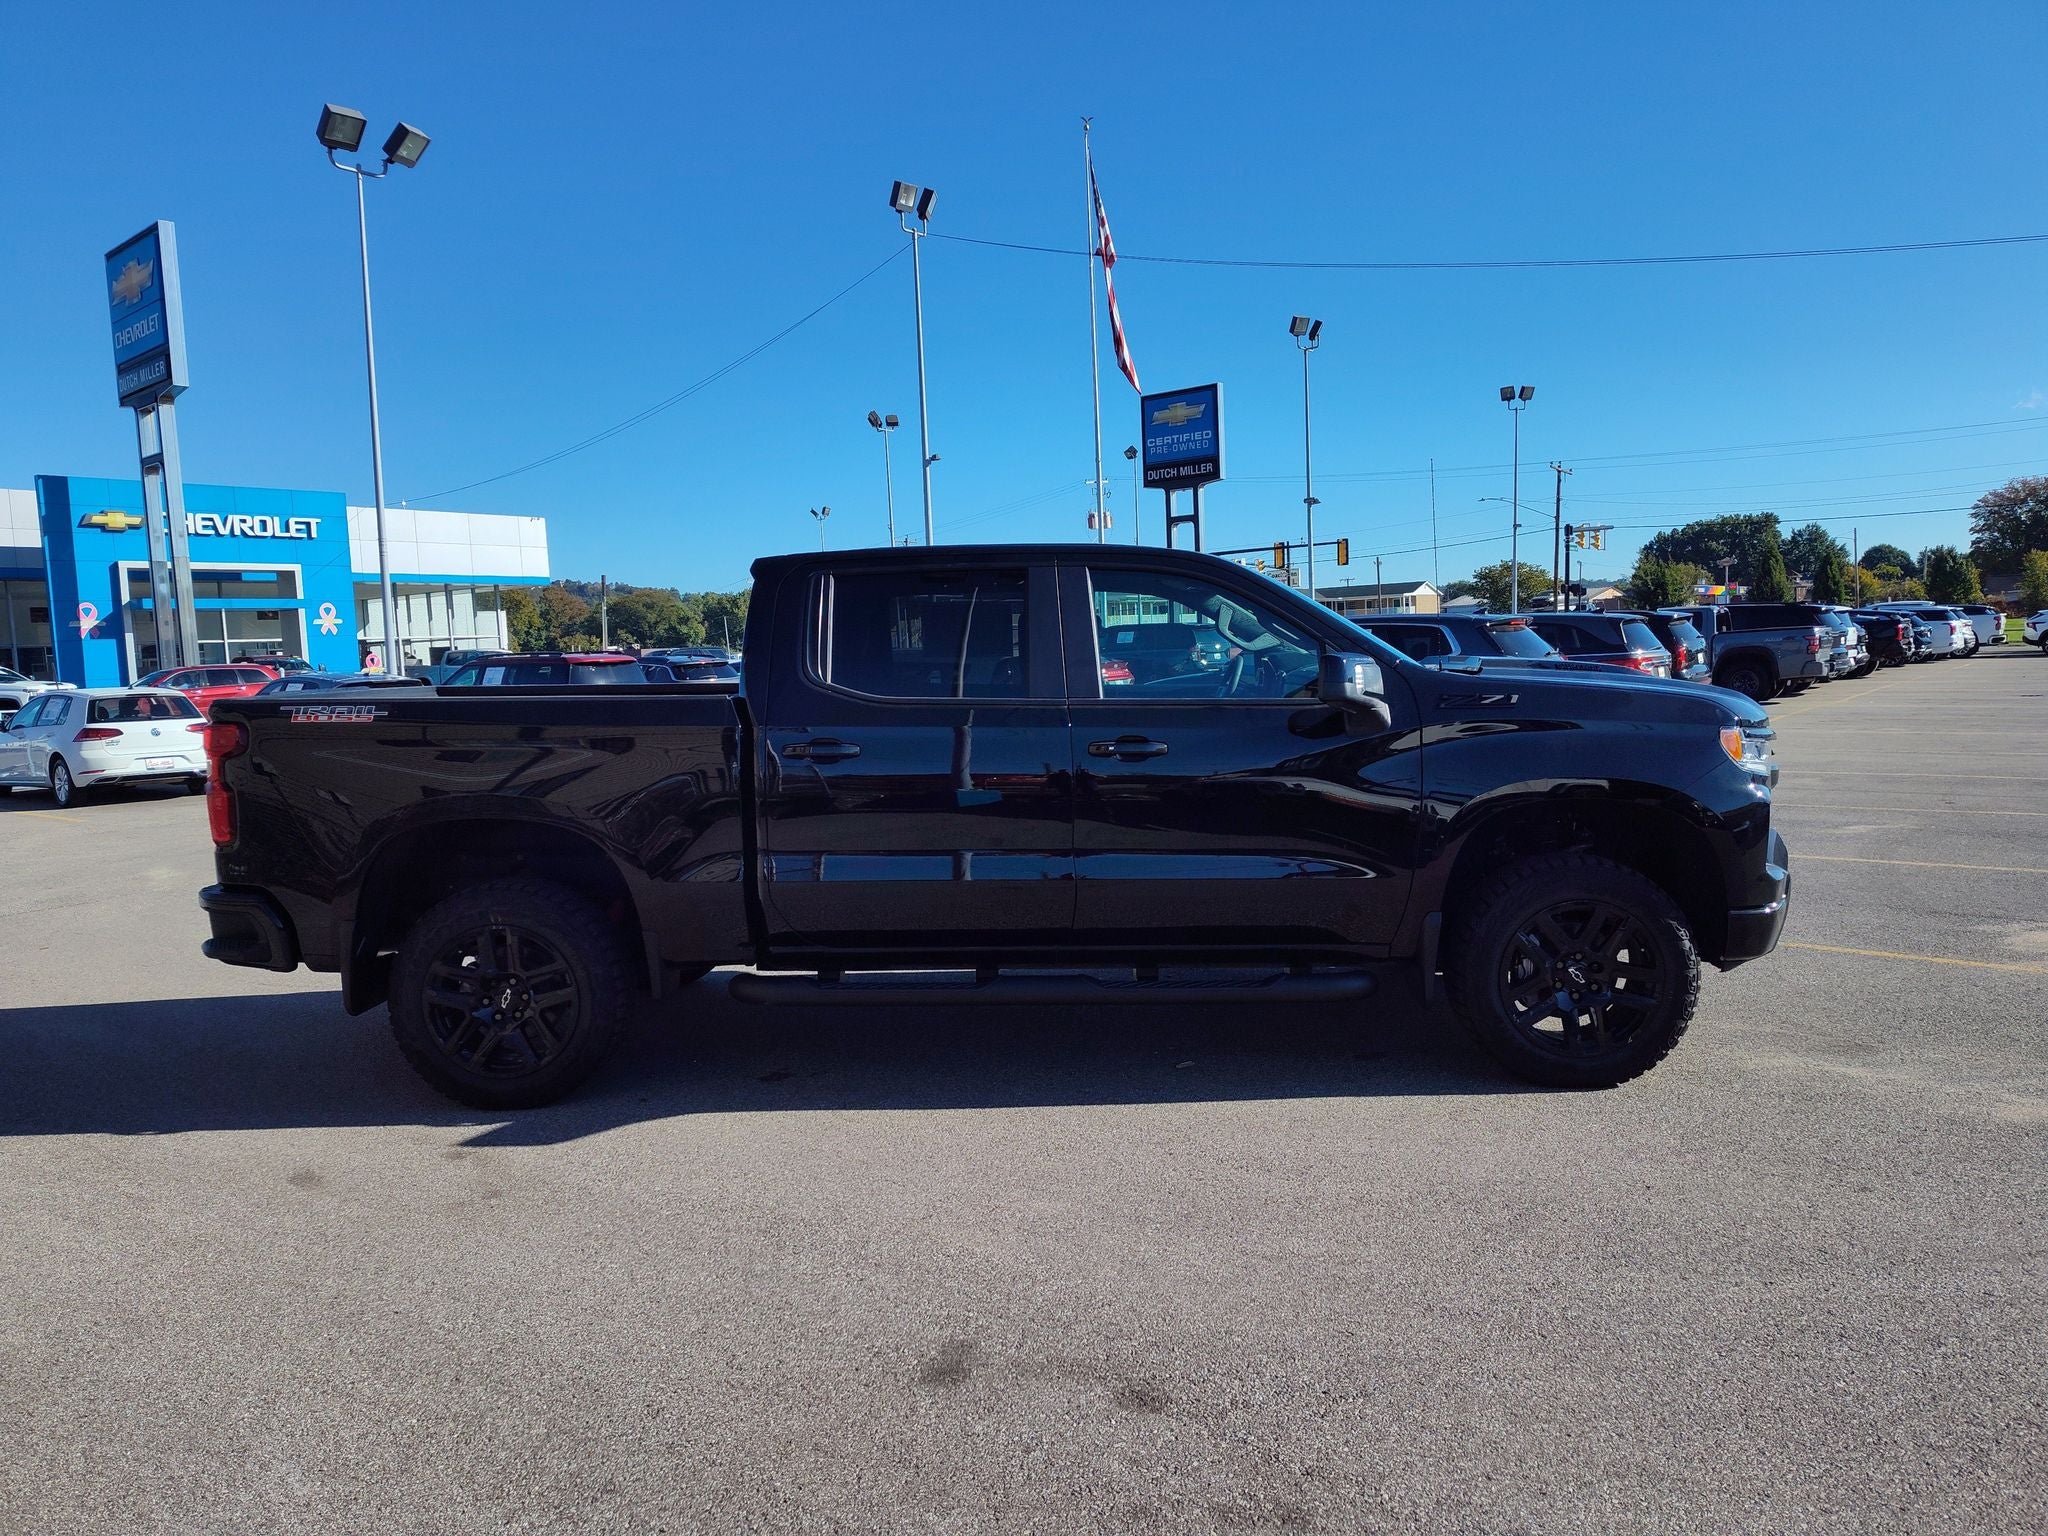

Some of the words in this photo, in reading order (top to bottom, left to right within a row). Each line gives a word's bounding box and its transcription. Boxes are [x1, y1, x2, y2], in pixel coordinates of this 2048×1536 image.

[115, 313, 159, 349] CHEVROLET
[119, 371, 138, 392] DUTCH
[139, 360, 166, 381] MILLER
[1147, 430, 1212, 447] CERTIFIED
[1150, 440, 1209, 455] PRE-OWNED
[1147, 467, 1177, 480] DUTCH
[1180, 463, 1213, 476] MILLER
[1440, 693, 1520, 708] Z71
[280, 705, 388, 716] TRAIL
[291, 714, 374, 723] BOSS
